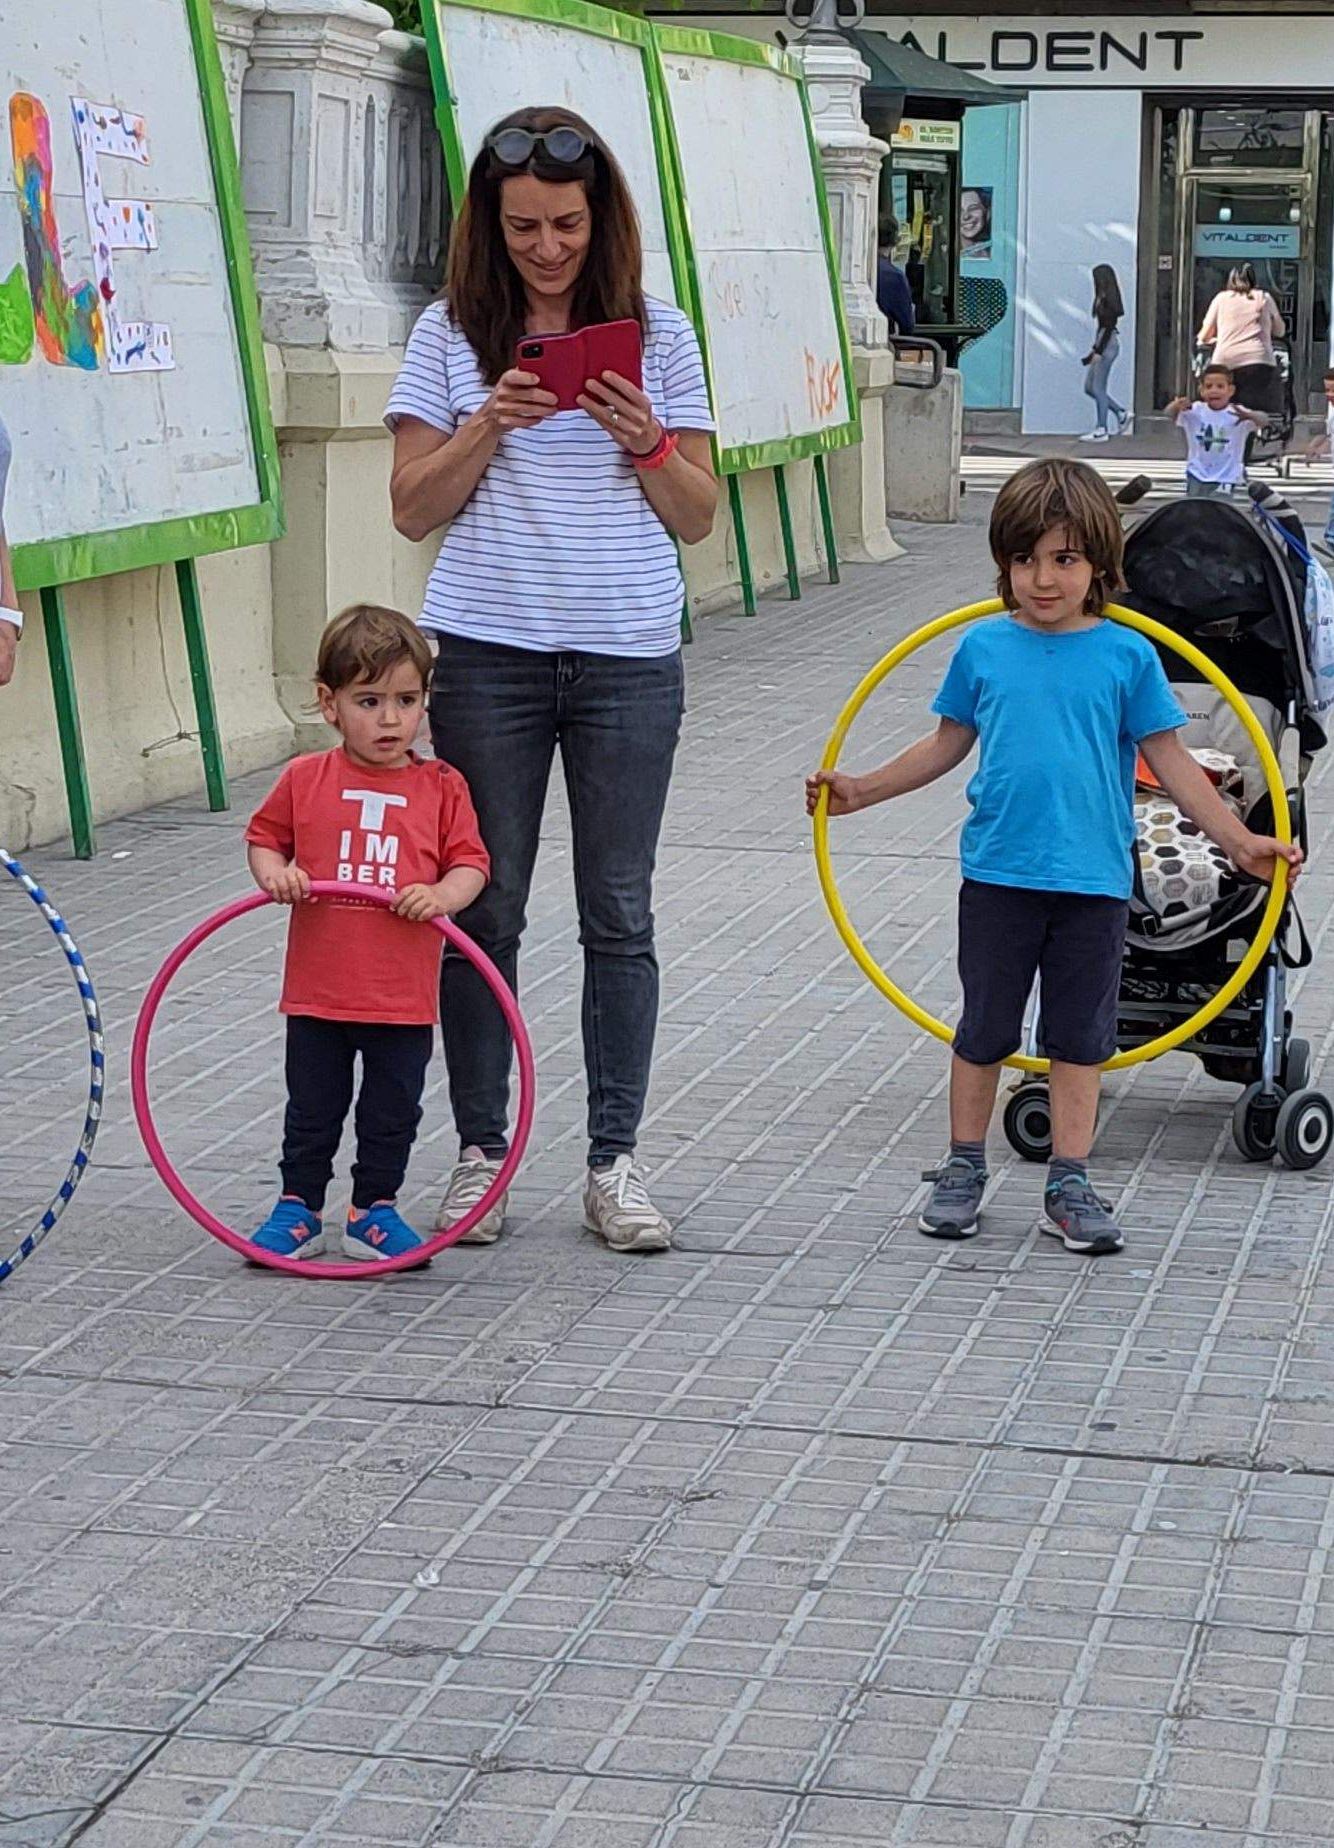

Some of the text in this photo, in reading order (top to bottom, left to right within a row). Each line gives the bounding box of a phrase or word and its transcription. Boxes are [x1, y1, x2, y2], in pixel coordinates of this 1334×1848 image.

[775, 31, 1204, 71] LDENT
[1202, 232, 1290, 243] VITALDENT
[341, 789, 408, 831] T
[337, 863, 396, 886] BER
